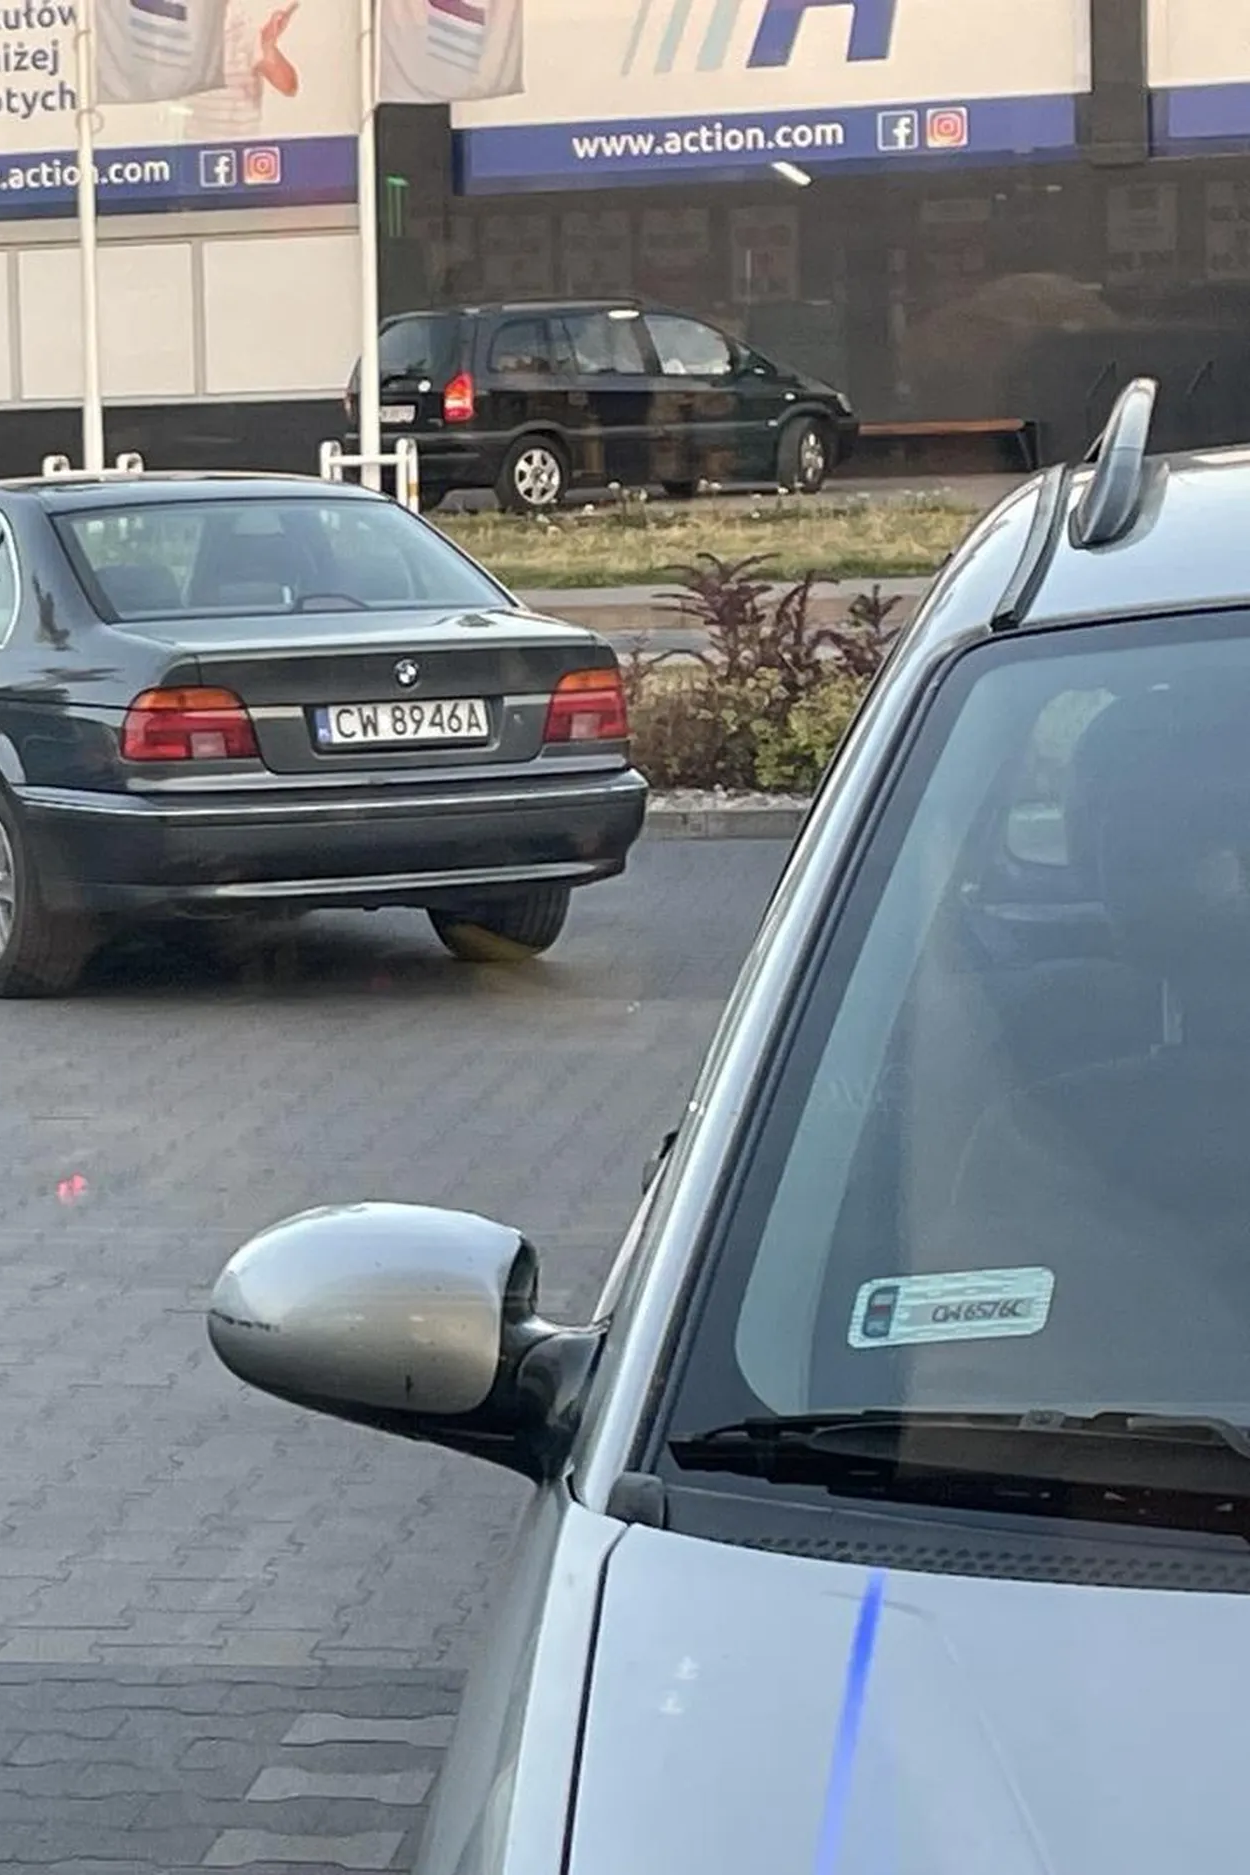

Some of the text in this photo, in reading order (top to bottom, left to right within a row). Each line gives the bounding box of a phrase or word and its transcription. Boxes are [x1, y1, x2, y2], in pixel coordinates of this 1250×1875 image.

[571, 122, 845, 159] www.action.com
[335, 707, 379, 738] CW
[391, 703, 483, 736] 8946A
